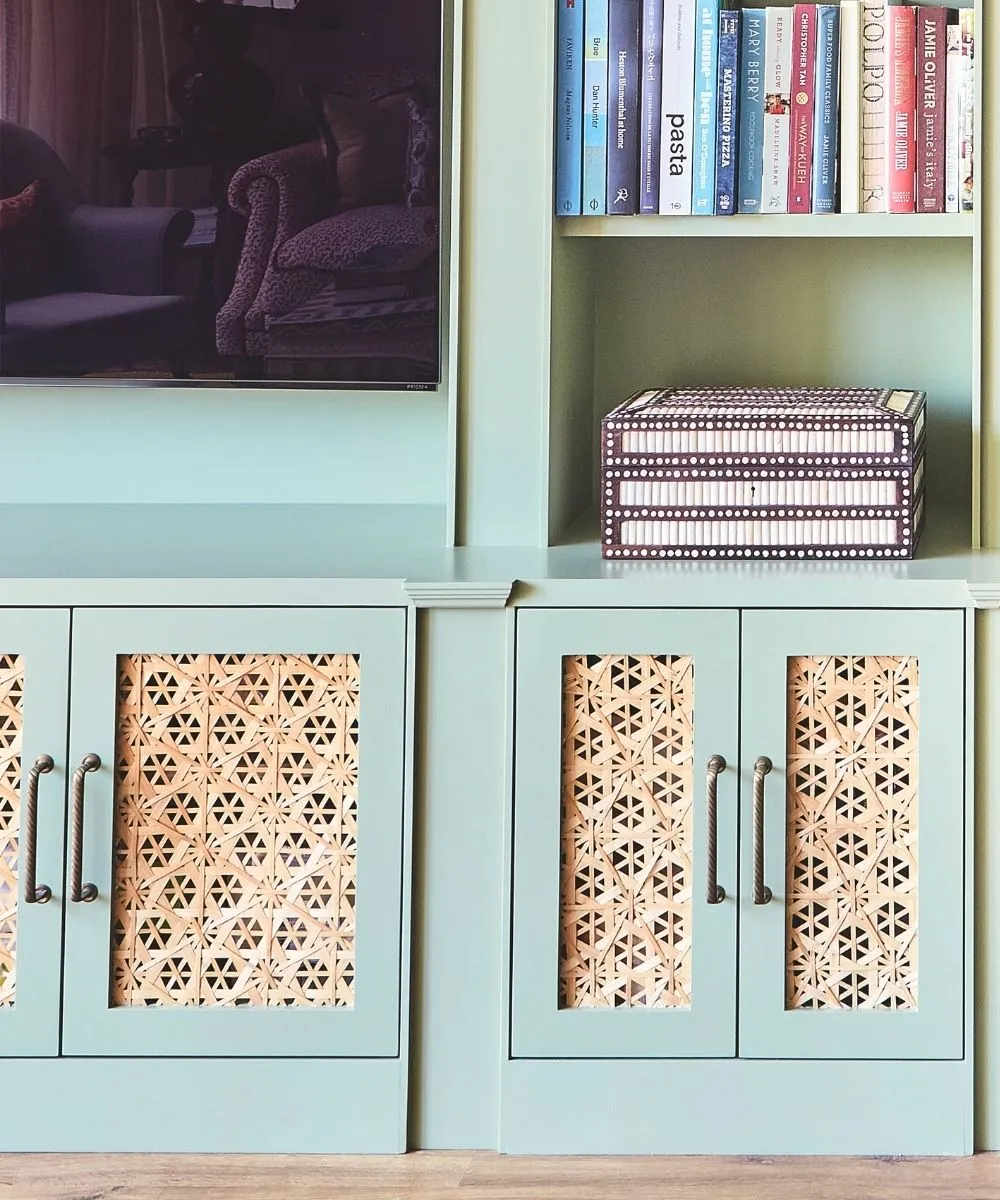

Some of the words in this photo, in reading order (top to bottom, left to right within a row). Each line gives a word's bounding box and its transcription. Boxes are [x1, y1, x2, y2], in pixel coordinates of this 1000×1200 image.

[702, 7, 713, 25] at
[593, 37, 601, 56] Brae
[748, 19, 760, 55] MARY
[800, 14, 809, 68] CHRISTOPHER
[924, 19, 936, 57] JAMIE
[618, 50, 627, 77] Heston
[702, 29, 713, 77] home
[863, 4, 885, 103] POLPO
[592, 85, 600, 100] Dan
[747, 61, 759, 103] BERRY
[799, 71, 807, 87] TAN
[618, 78, 627, 120] Blumenthal
[700, 91, 712, 125] ben
[722, 68, 733, 132] MASTERING
[592, 102, 600, 129] Hunter
[895, 111, 908, 137] JAMIE
[617, 129, 625, 149] home
[666, 114, 687, 176] pasta
[700, 128, 708, 142] Ben
[798, 126, 807, 148] WAY
[924, 112, 936, 157] jamie's
[721, 135, 731, 167] PIZZA
[799, 147, 804, 155] OF
[895, 139, 908, 170] OLIVER
[797, 155, 806, 185] KUEH
[922, 162, 935, 190] italy
